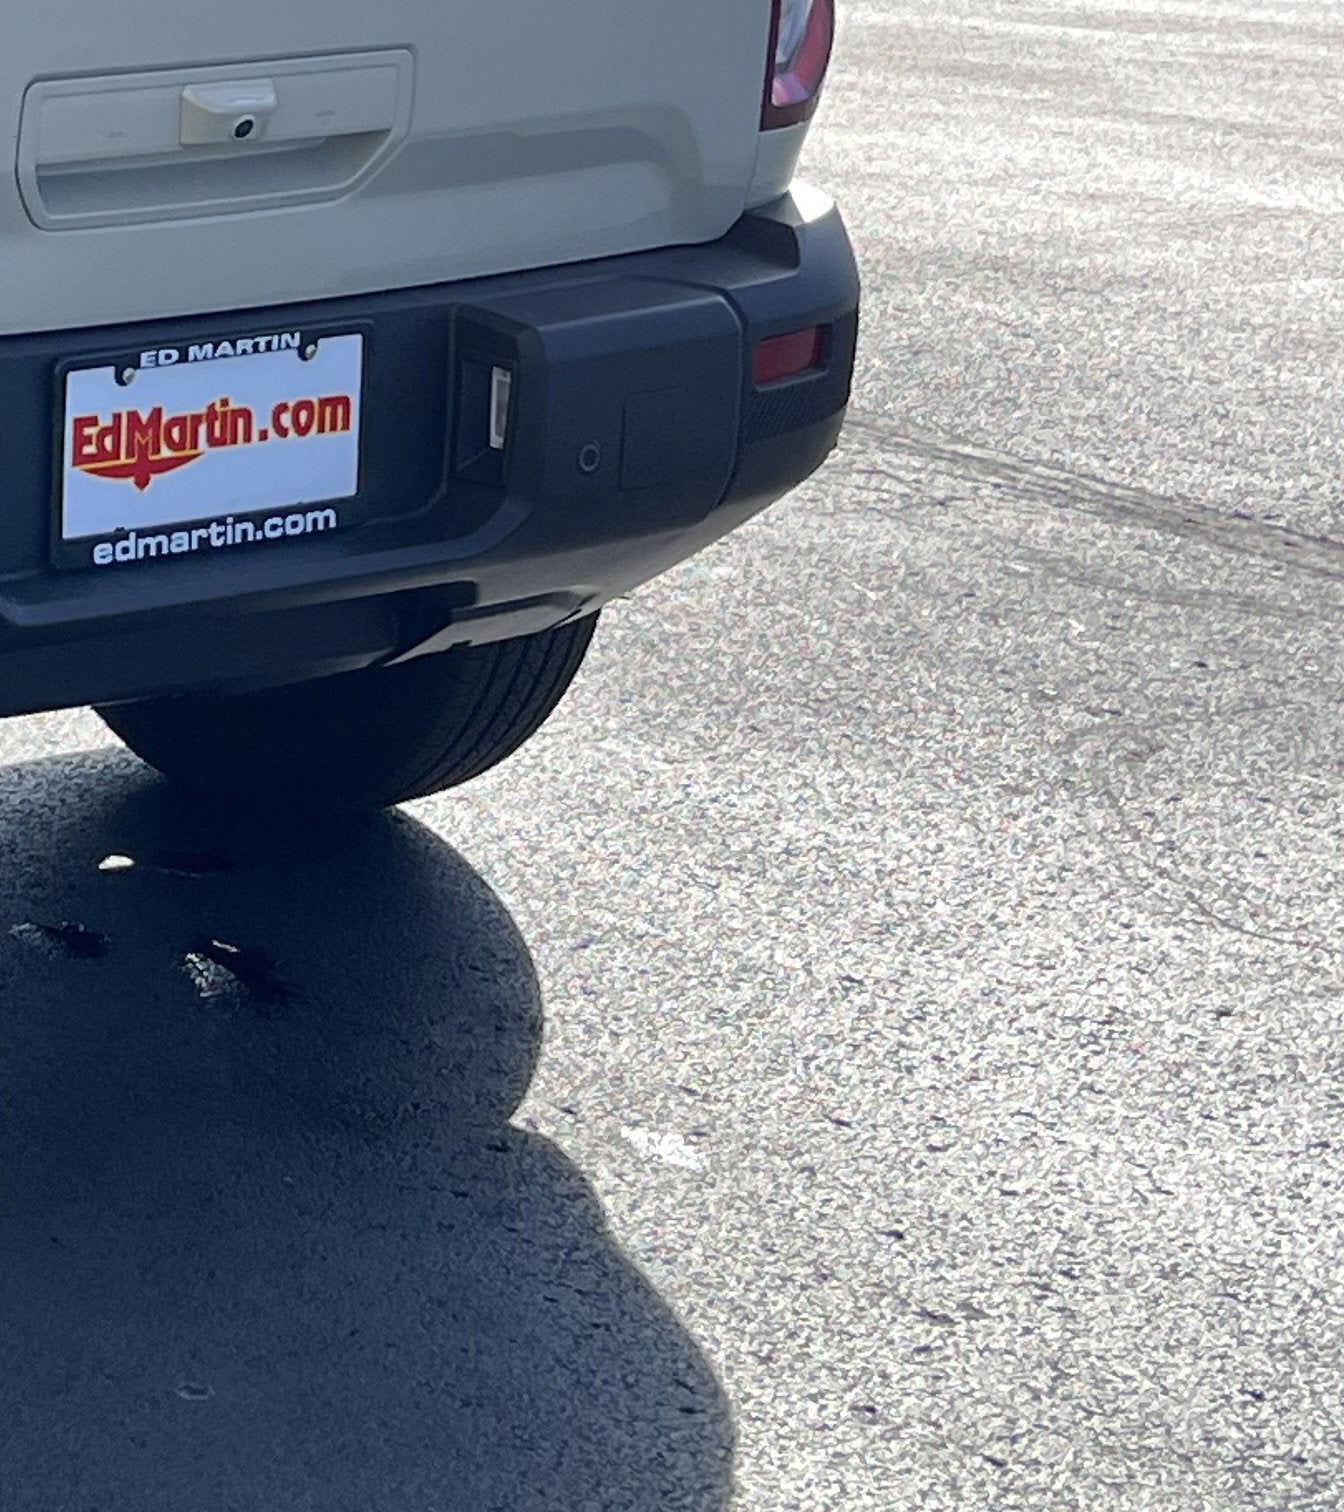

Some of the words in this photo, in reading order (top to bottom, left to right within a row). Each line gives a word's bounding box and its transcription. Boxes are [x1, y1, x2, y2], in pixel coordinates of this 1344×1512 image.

[139, 348, 180, 369] ED
[187, 331, 302, 363] MARTIN
[92, 506, 338, 566] edmartin.com
